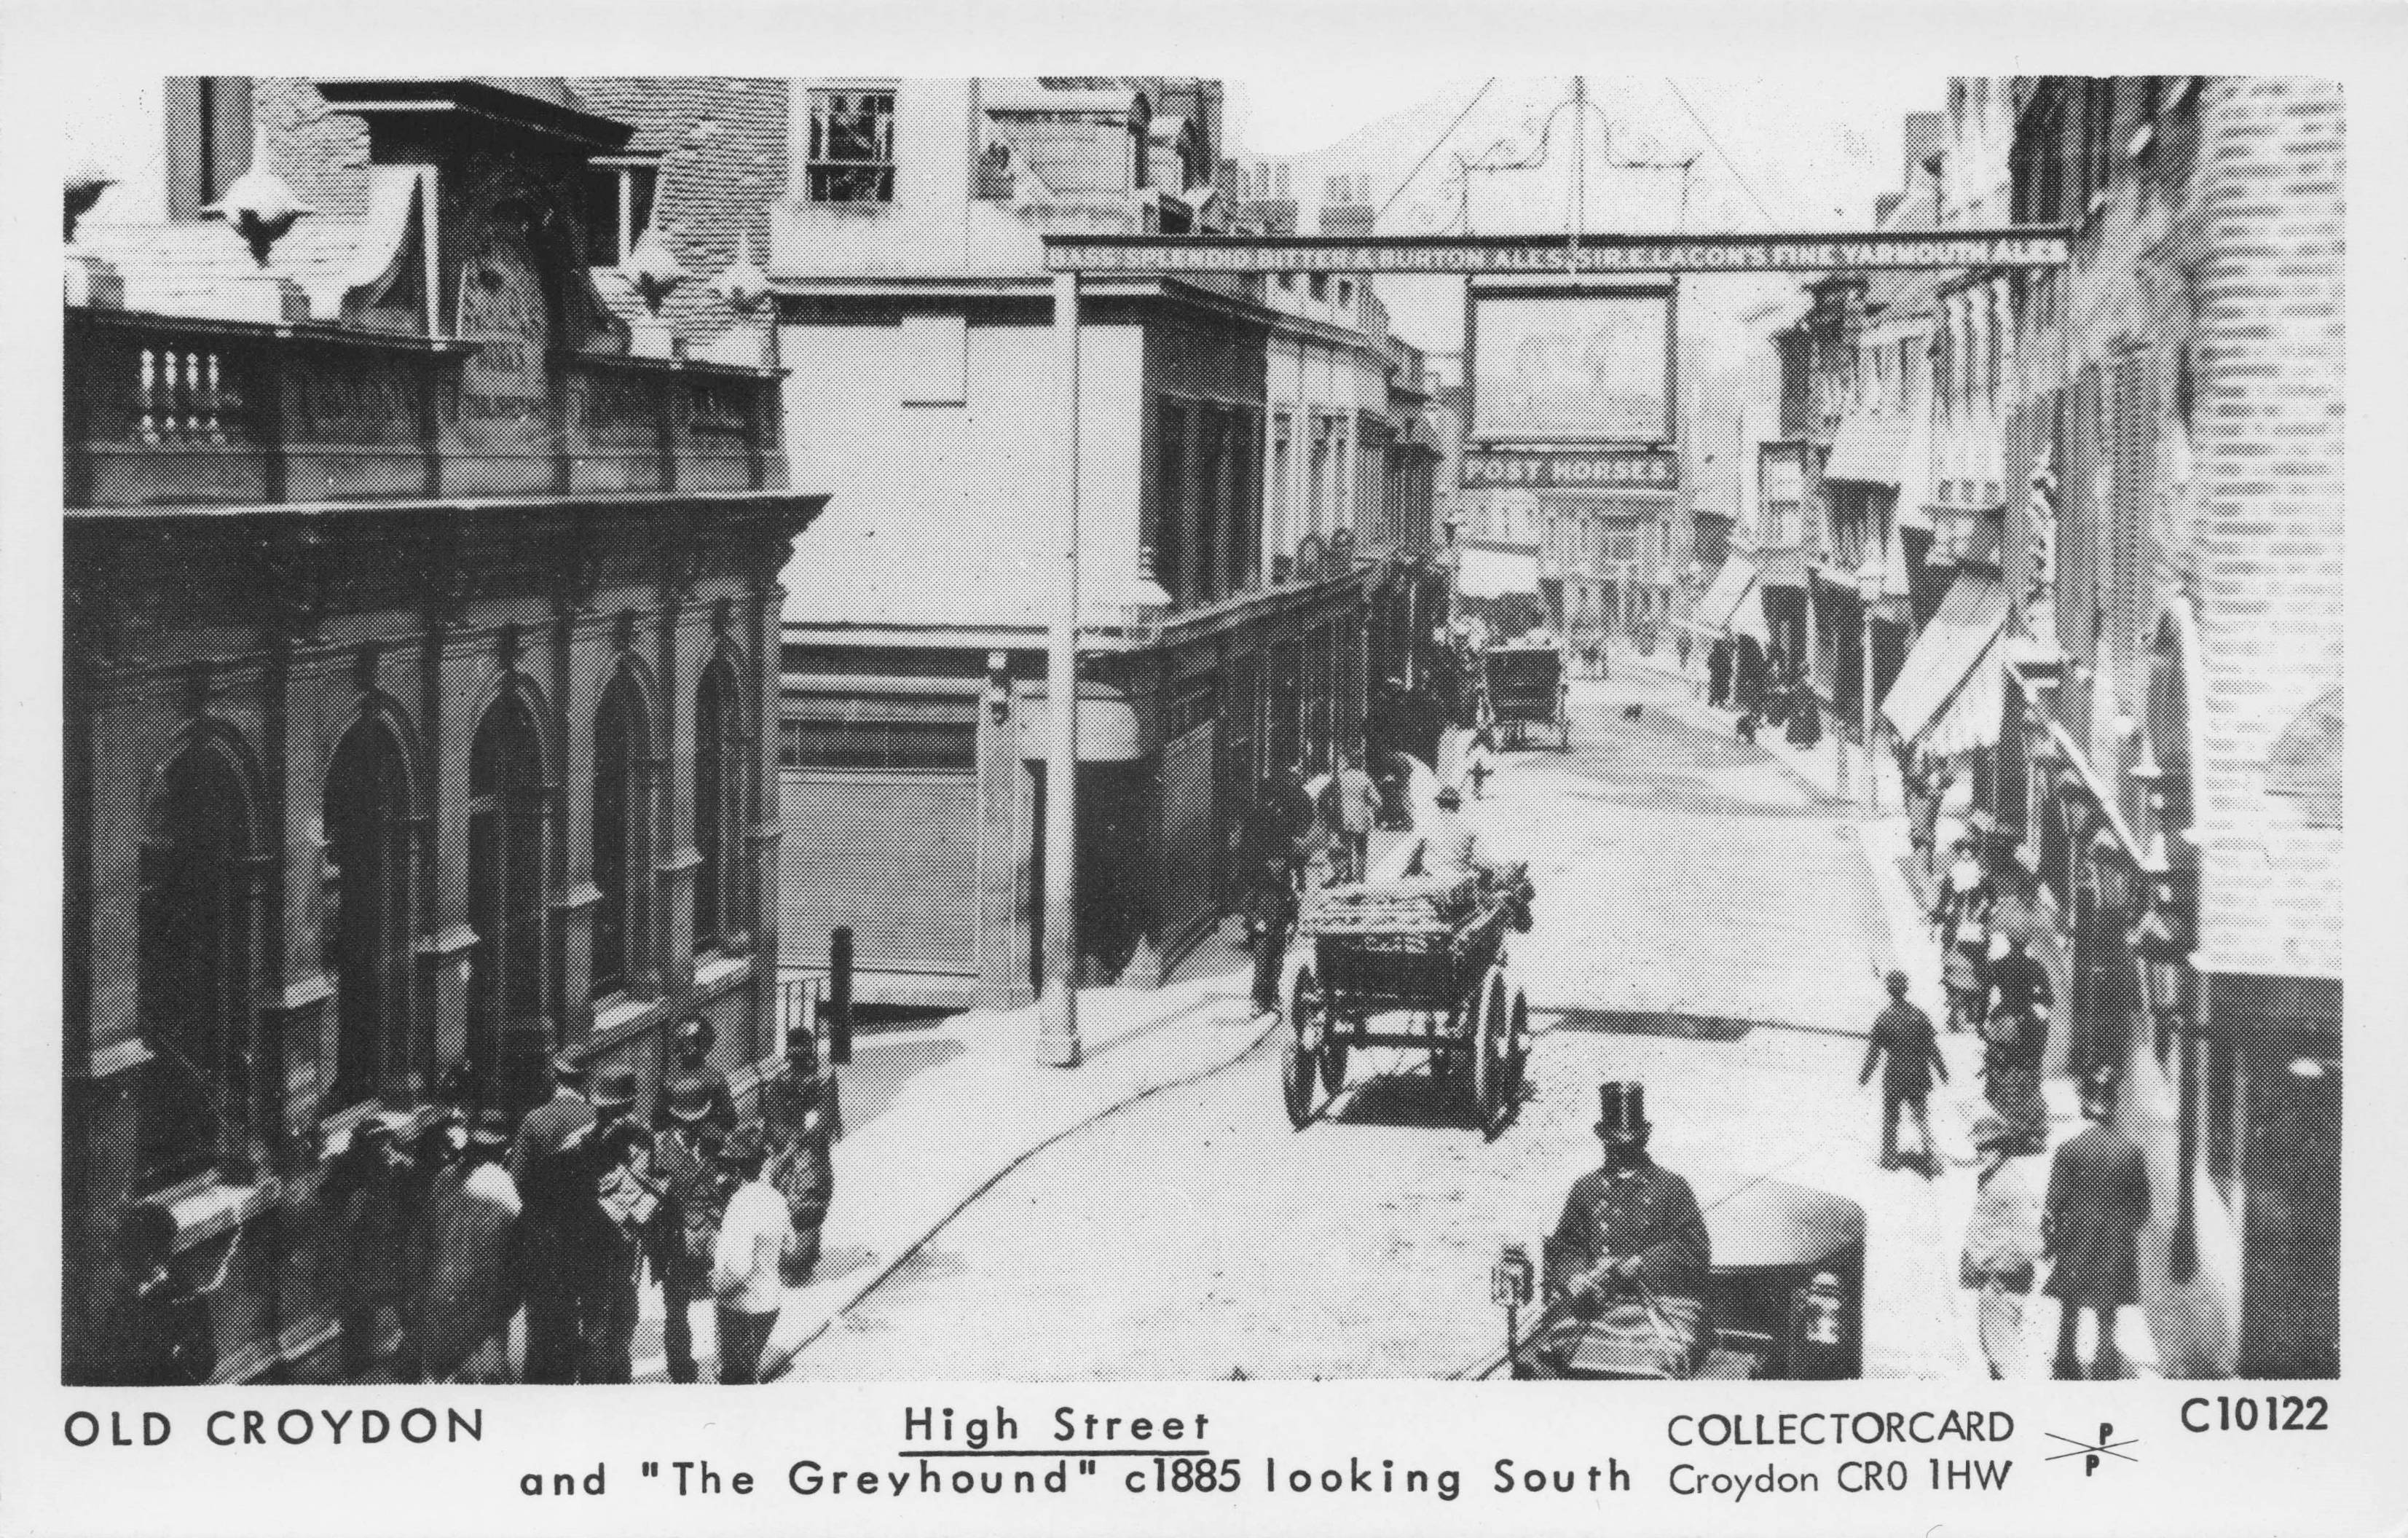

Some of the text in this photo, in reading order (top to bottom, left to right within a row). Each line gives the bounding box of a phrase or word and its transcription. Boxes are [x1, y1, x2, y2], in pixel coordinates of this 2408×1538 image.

[1049, 248, 1116, 268] BASS
[1123, 248, 1251, 268] SPLENDID
[1256, 248, 1348, 269] BITTER
[1353, 248, 1374, 269] &
[1378, 248, 1485, 269] BURTON
[1772, 245, 1835, 266] FINE
[1841, 241, 1988, 265] YARMOUTH
[1991, 238, 2069, 263] ALES
[1465, 460, 1542, 482] POST
